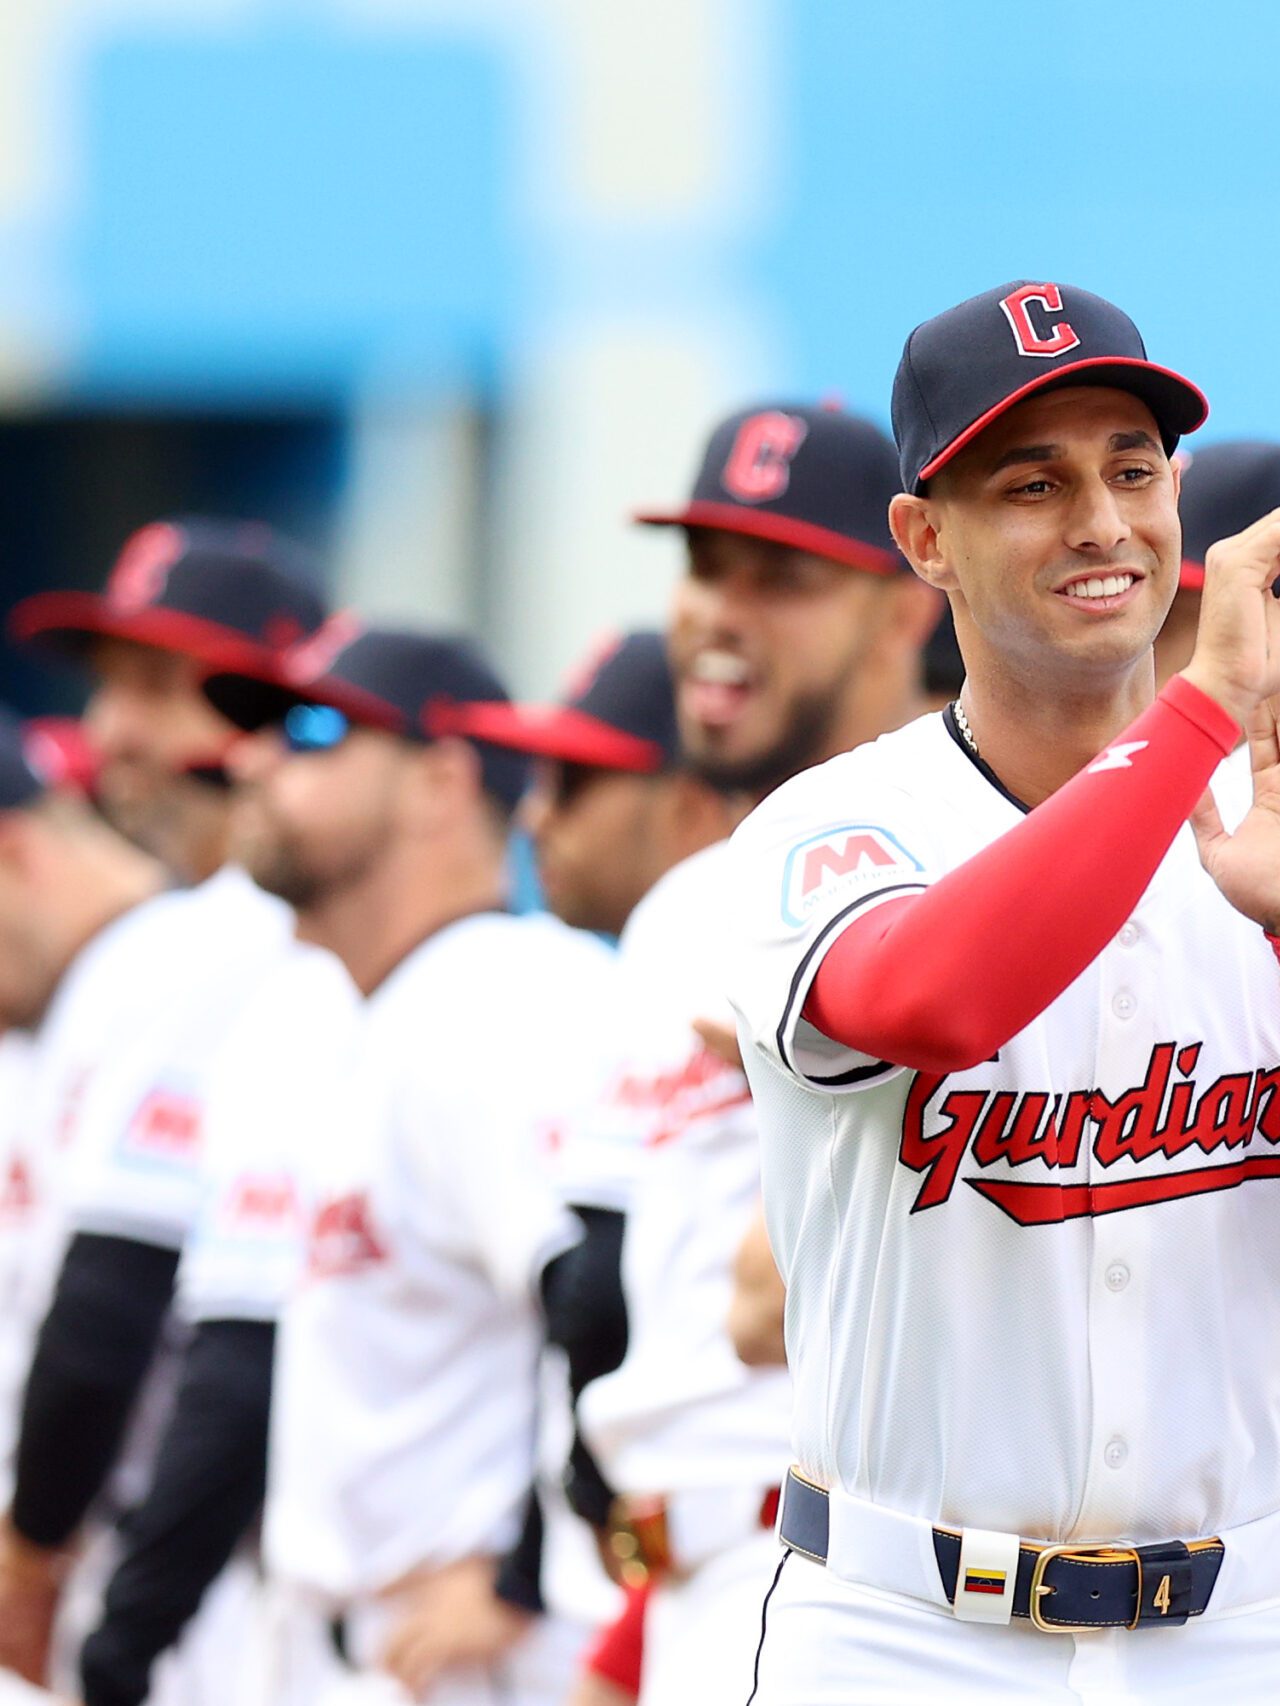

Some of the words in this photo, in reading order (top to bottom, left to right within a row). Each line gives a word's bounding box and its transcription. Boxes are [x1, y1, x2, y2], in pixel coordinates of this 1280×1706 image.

[1000, 283, 1081, 358] C
[723, 410, 808, 503] C
[802, 834, 897, 897] M
[1153, 1574, 1171, 1615] 4
